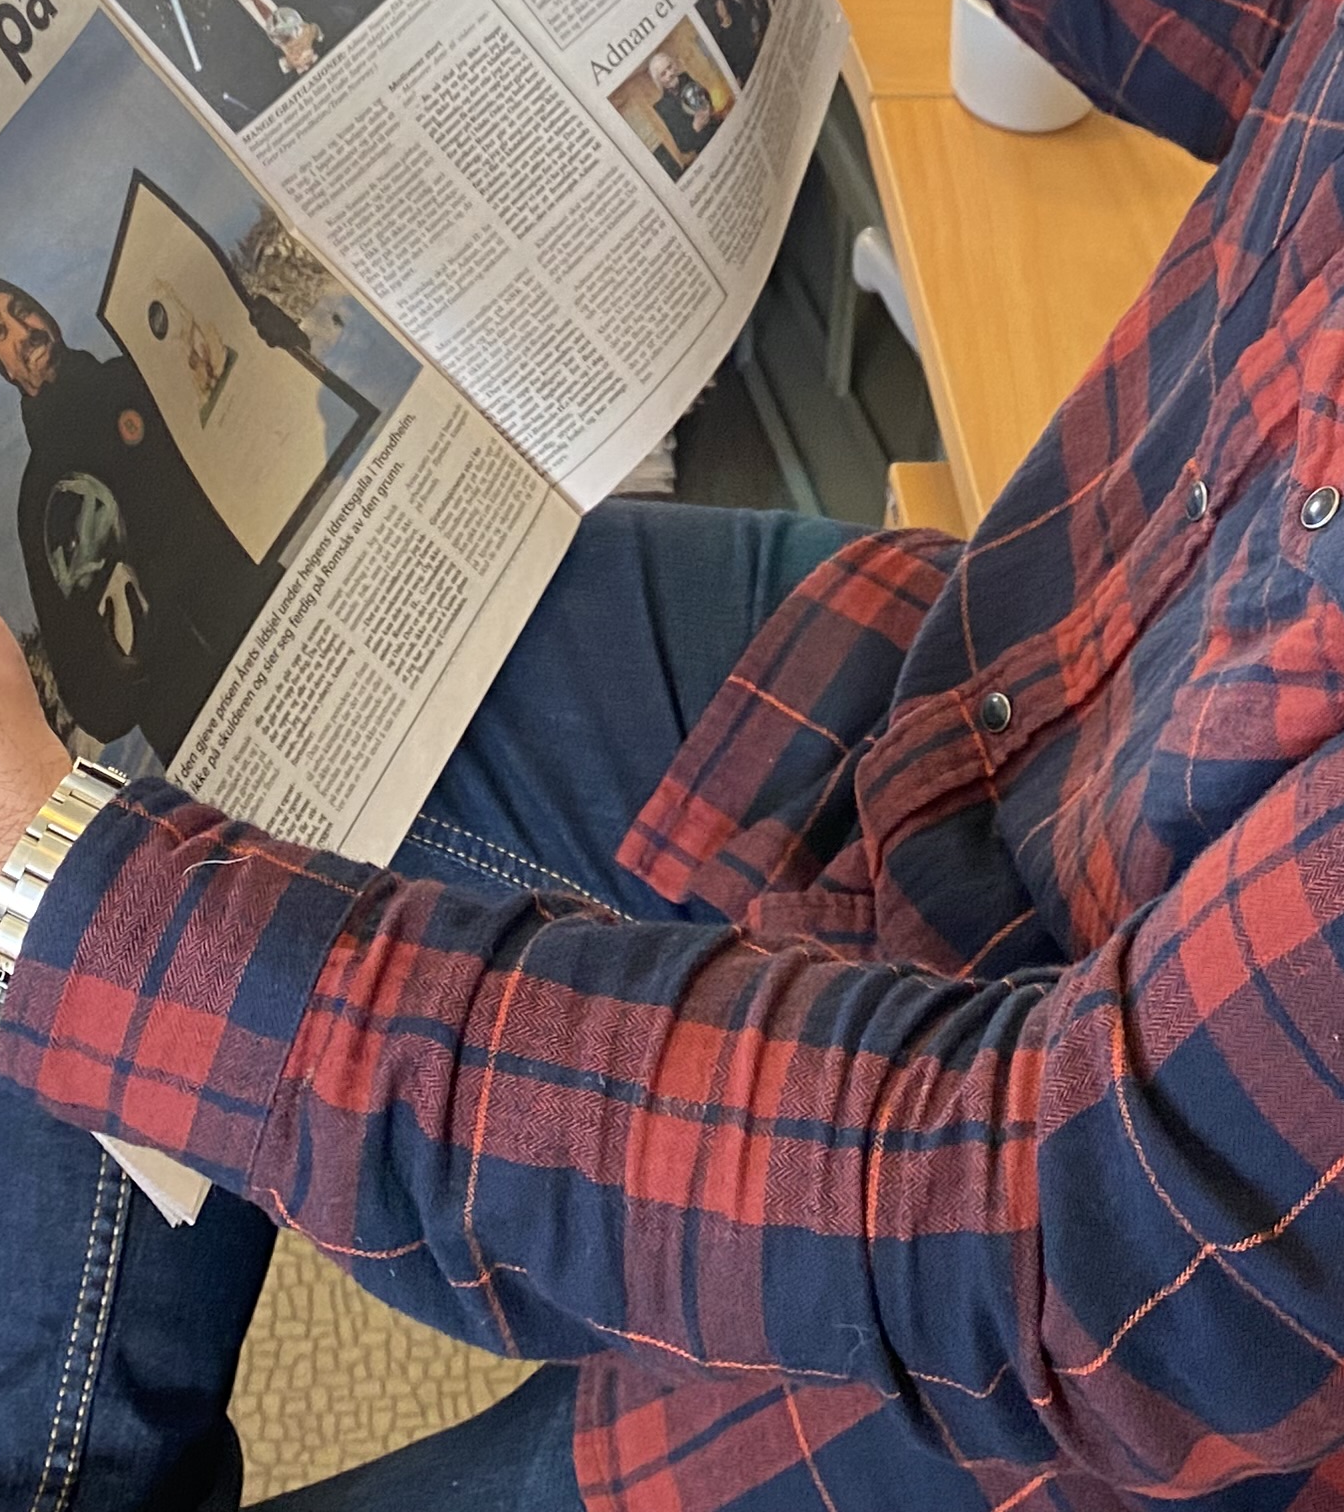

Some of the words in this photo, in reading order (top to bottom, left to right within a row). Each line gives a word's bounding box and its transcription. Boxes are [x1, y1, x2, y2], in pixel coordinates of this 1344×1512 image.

[241, 114, 275, 144] MANGE
[273, 52, 348, 115] GRATULASJONER:
[590, 14, 656, 87] Adnan
[180, 753, 199, 779] den
[195, 716, 219, 753] gjeve
[215, 679, 241, 722] prisen
[234, 647, 261, 680] Årets
[278, 579, 304, 616] under
[301, 535, 334, 583] helgens
[190, 766, 211, 796] ikke
[208, 745, 222, 770] på
[218, 689, 256, 750] skulderen
[253, 672, 269, 692] og
[263, 650, 281, 674] sier
[279, 627, 297, 652] seg
[289, 591, 319, 630] ferdig
[313, 569, 328, 597] på
[323, 532, 356, 579] Romsås
[353, 517, 366, 535] av
[362, 493, 382, 520] den
[377, 461, 407, 500] grunn.
